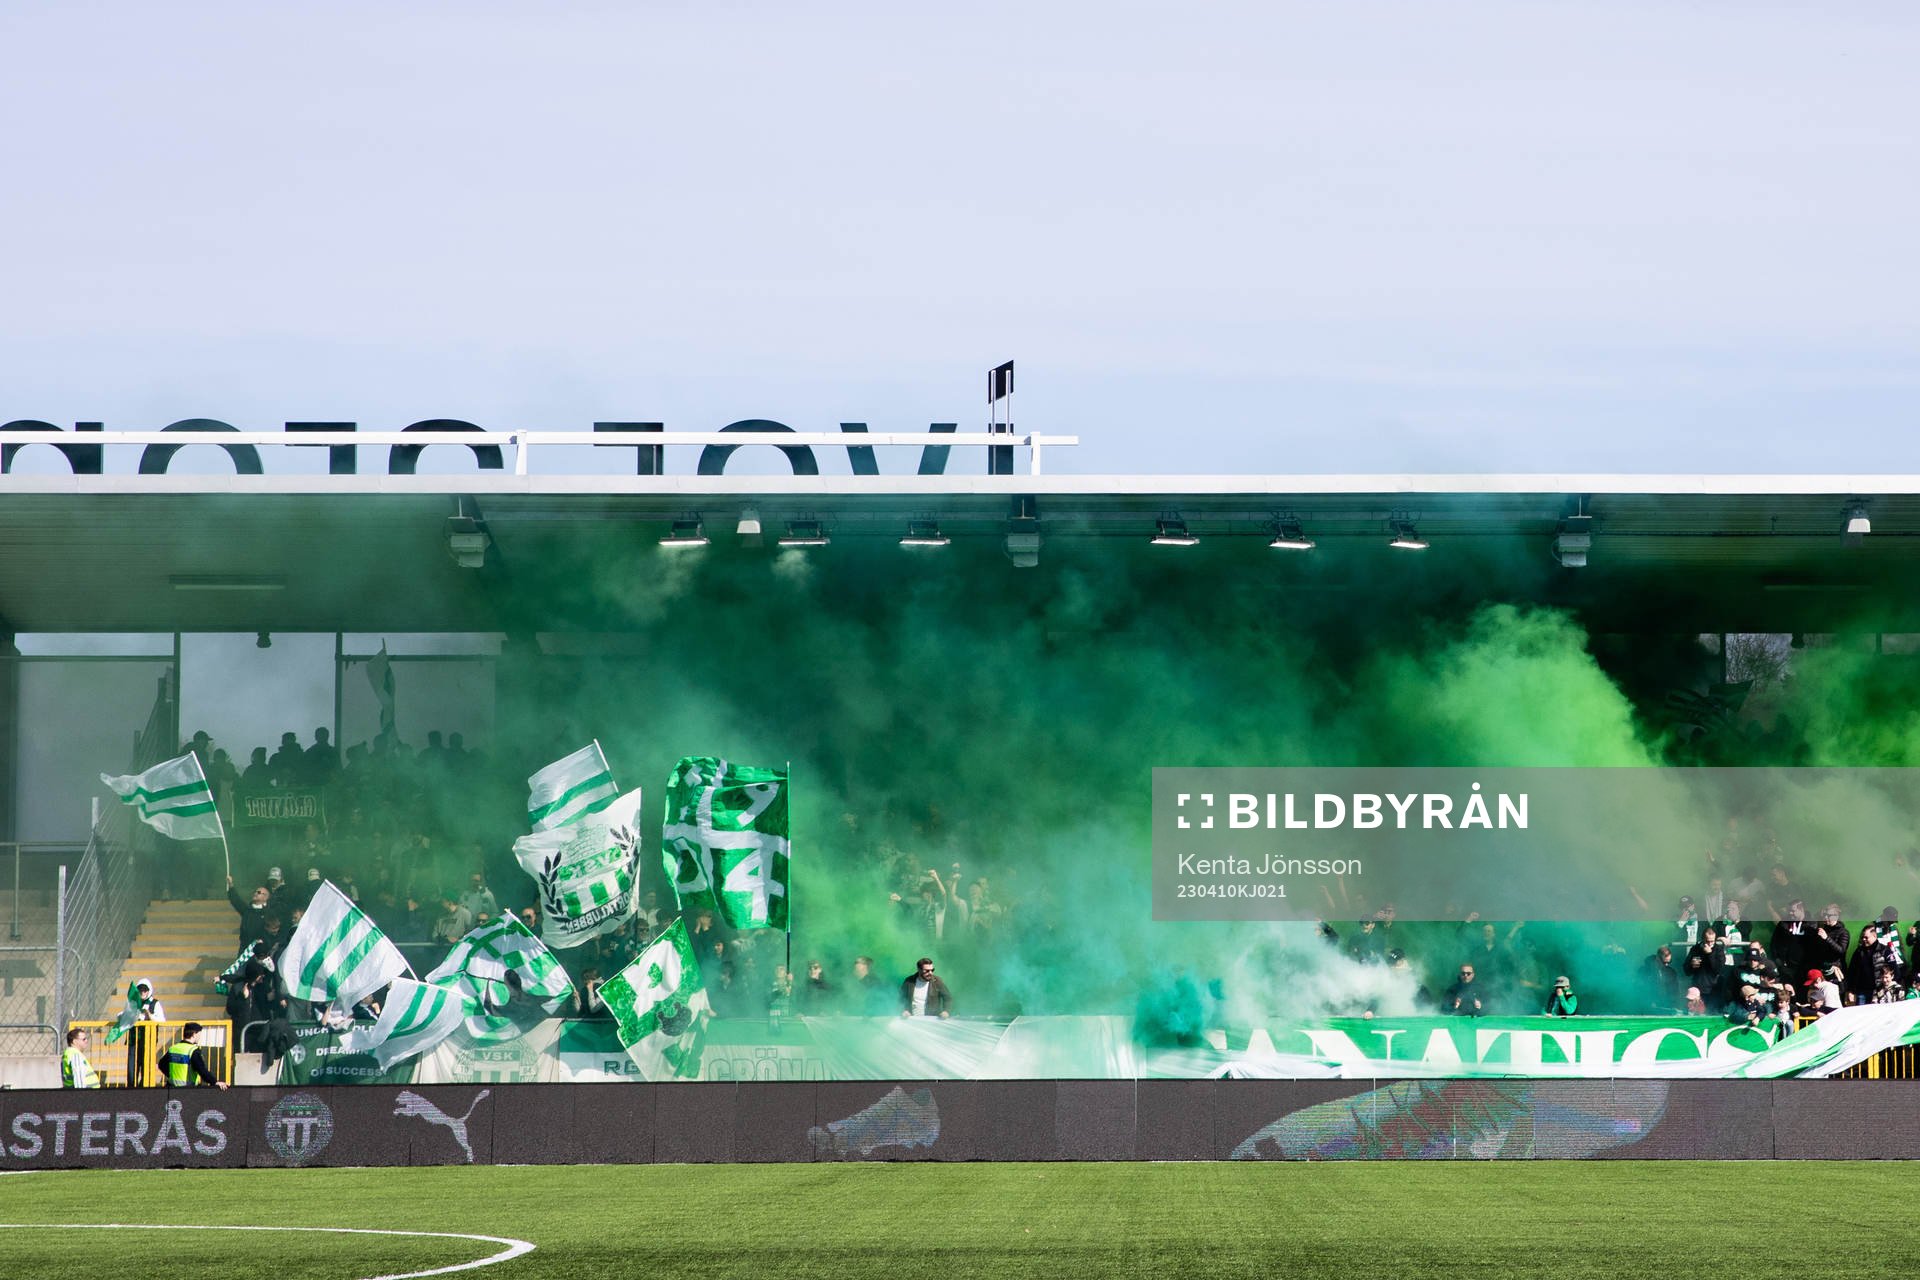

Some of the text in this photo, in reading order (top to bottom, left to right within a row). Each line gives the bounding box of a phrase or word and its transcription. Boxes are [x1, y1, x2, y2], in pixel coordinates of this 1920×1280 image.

[483, 1052, 513, 1060] VSK
[326, 1066, 382, 1076] SUCCESS
[0, 1100, 227, 1157] STERÅS
